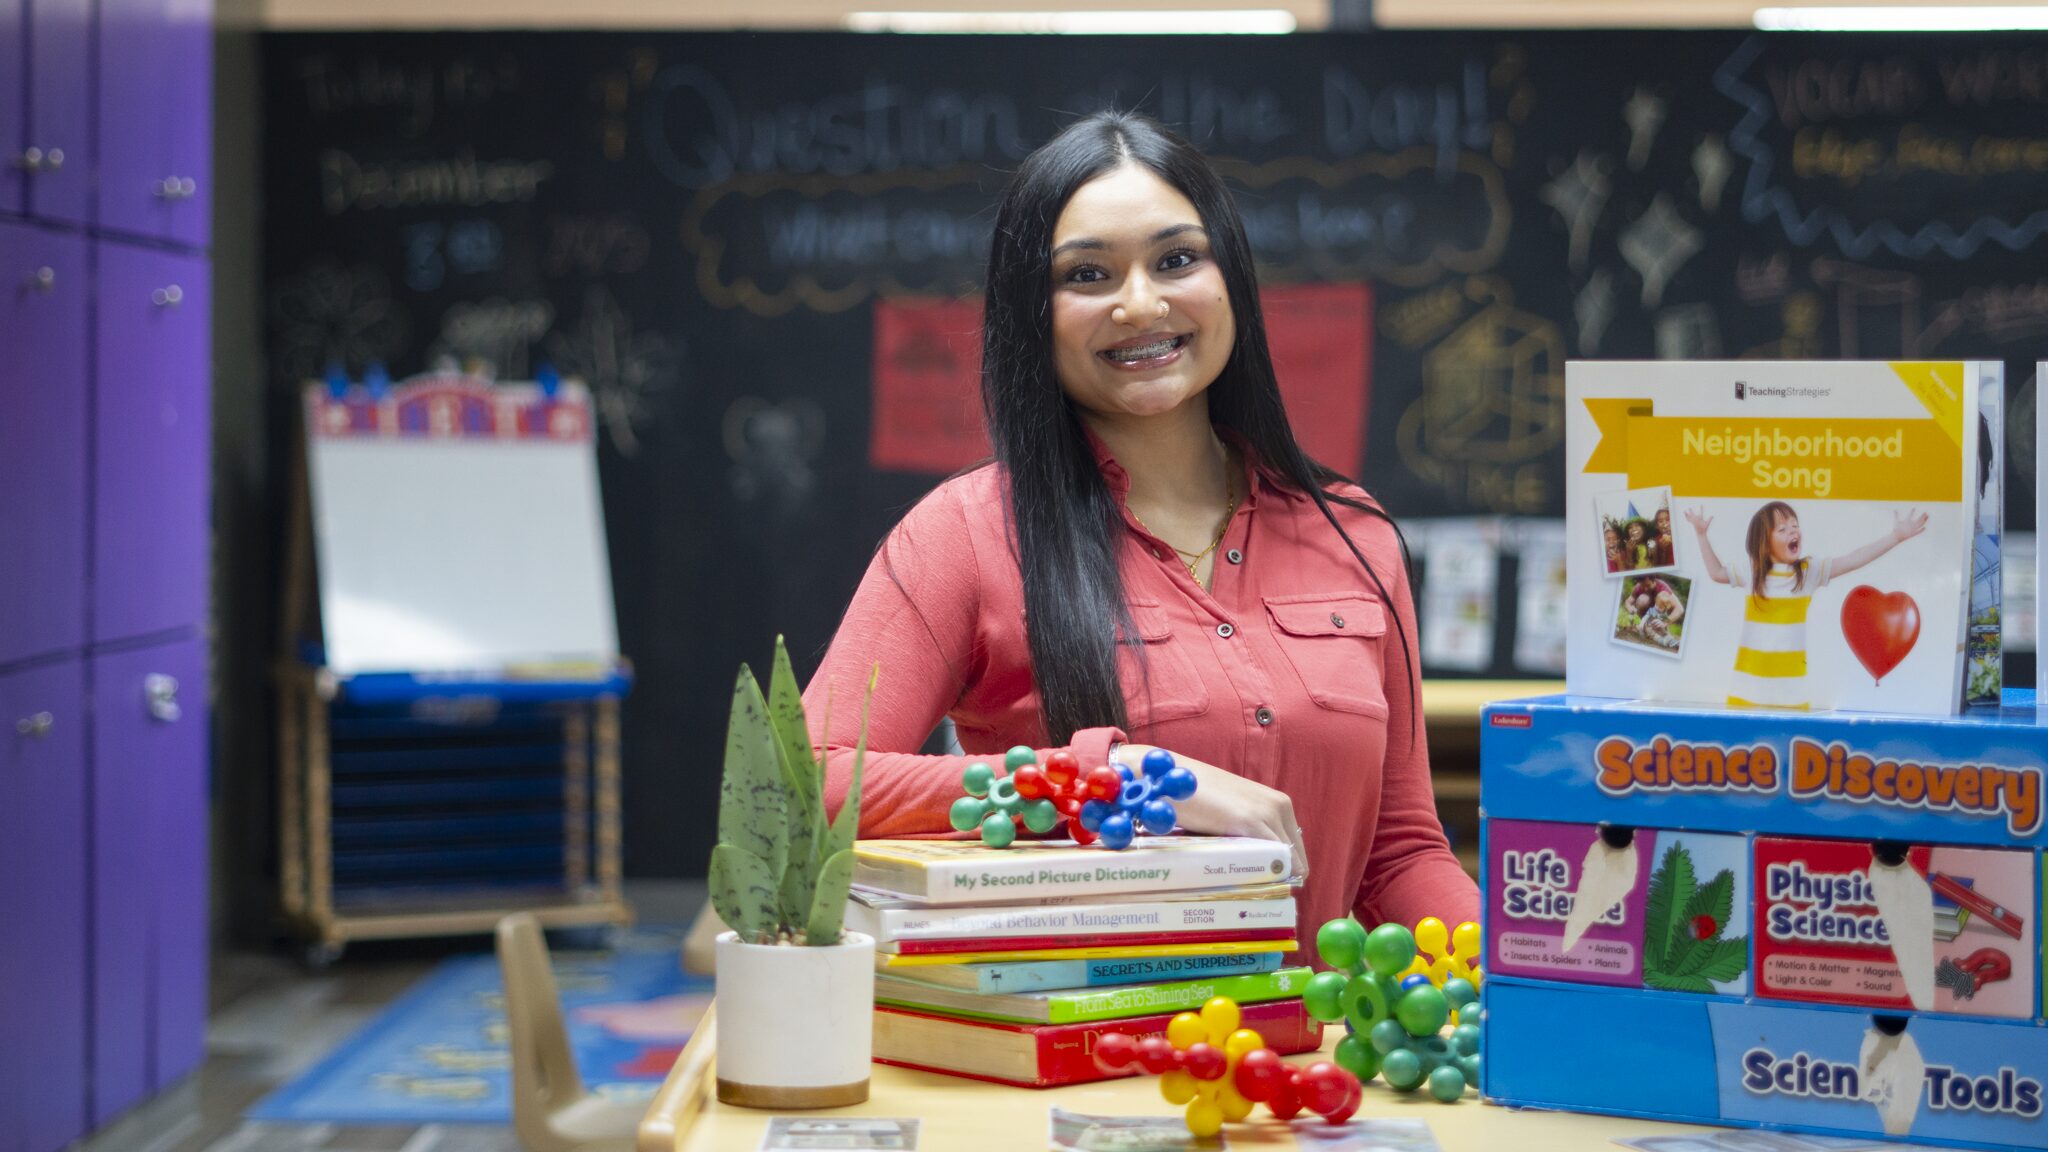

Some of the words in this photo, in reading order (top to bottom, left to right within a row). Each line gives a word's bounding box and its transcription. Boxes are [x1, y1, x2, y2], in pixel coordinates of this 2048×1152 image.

[1682, 427, 1903, 464] Neighborhood
[1752, 460, 1832, 497] Song
[1598, 736, 1778, 793] Science
[1790, 737, 2041, 835] Discovery
[1203, 864, 1227, 875] Scott,
[1229, 863, 1265, 874] Foresman
[1506, 851, 1567, 885] Life
[954, 873, 976, 890] My
[981, 871, 1034, 887] Second
[1039, 869, 1091, 884] Picture
[1096, 867, 1171, 882] Dictionary
[1007, 910, 1068, 929] Behavior
[1072, 910, 1159, 929] Management
[1183, 908, 1215, 917] SECOND
[1183, 916, 1215, 924] EDITION
[1510, 936, 1547, 948] Habitats
[1594, 944, 1629, 956] Animals
[1093, 961, 1154, 977] SECRETS
[1155, 959, 1182, 973] AND
[1184, 953, 1256, 970] SURPRISES
[1510, 950, 1540, 962] Insects
[1541, 953, 1549, 963] &
[1551, 954, 1582, 967] Spiders
[1594, 957, 1621, 969] Plants
[1775, 959, 1807, 971] Motion
[1808, 962, 1816, 971] &
[1818, 963, 1850, 974] Matter
[1775, 974, 1797, 986] Light
[1799, 976, 1807, 985] &
[1808, 977, 1832, 987] Color
[1863, 981, 1892, 992] Sound
[1074, 997, 1110, 1015] From
[1111, 993, 1131, 1010] Sea
[1132, 990, 1144, 1007] to
[1145, 985, 1190, 1007] Shining
[1191, 983, 1214, 999] Sea
[1925, 1066, 2041, 1115] Tools
